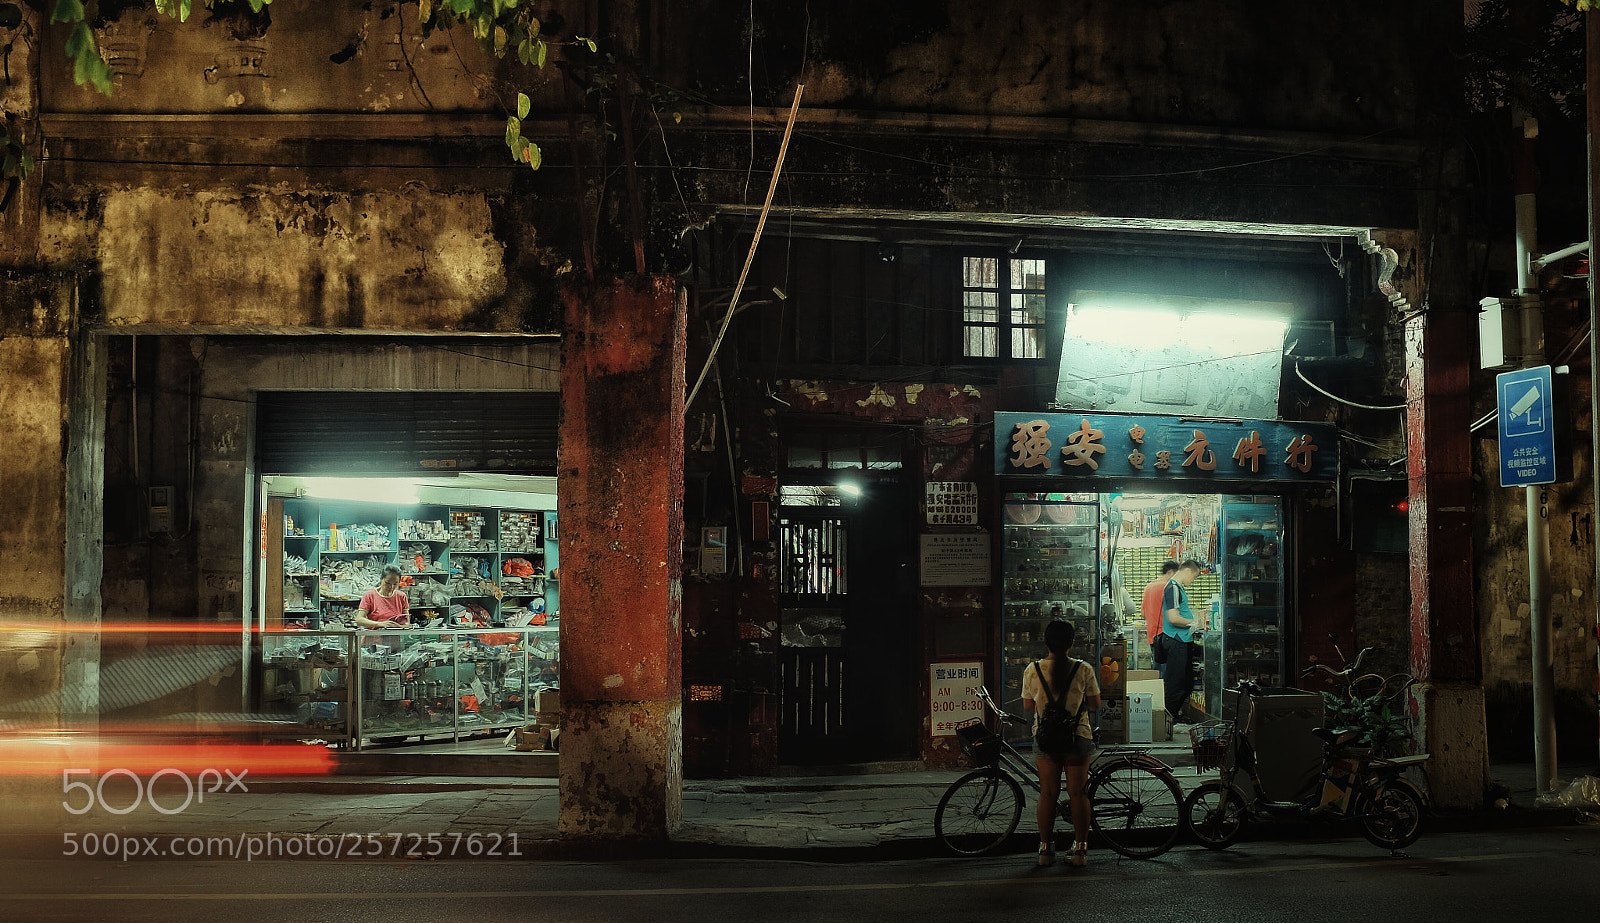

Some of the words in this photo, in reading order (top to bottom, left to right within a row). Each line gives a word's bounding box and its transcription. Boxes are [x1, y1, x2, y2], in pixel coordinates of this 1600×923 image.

[1011, 418, 1107, 470] 强安
[1181, 429, 1319, 473] 元件行
[1512, 446, 1539, 457] 公共安全
[1507, 456, 1547, 469] 视频监控区域
[1517, 468, 1537, 478] VIDEO
[935, 667, 979, 680] 营业时间
[937, 687, 951, 697] AM
[932, 700, 983, 712] 9:00-8:30
